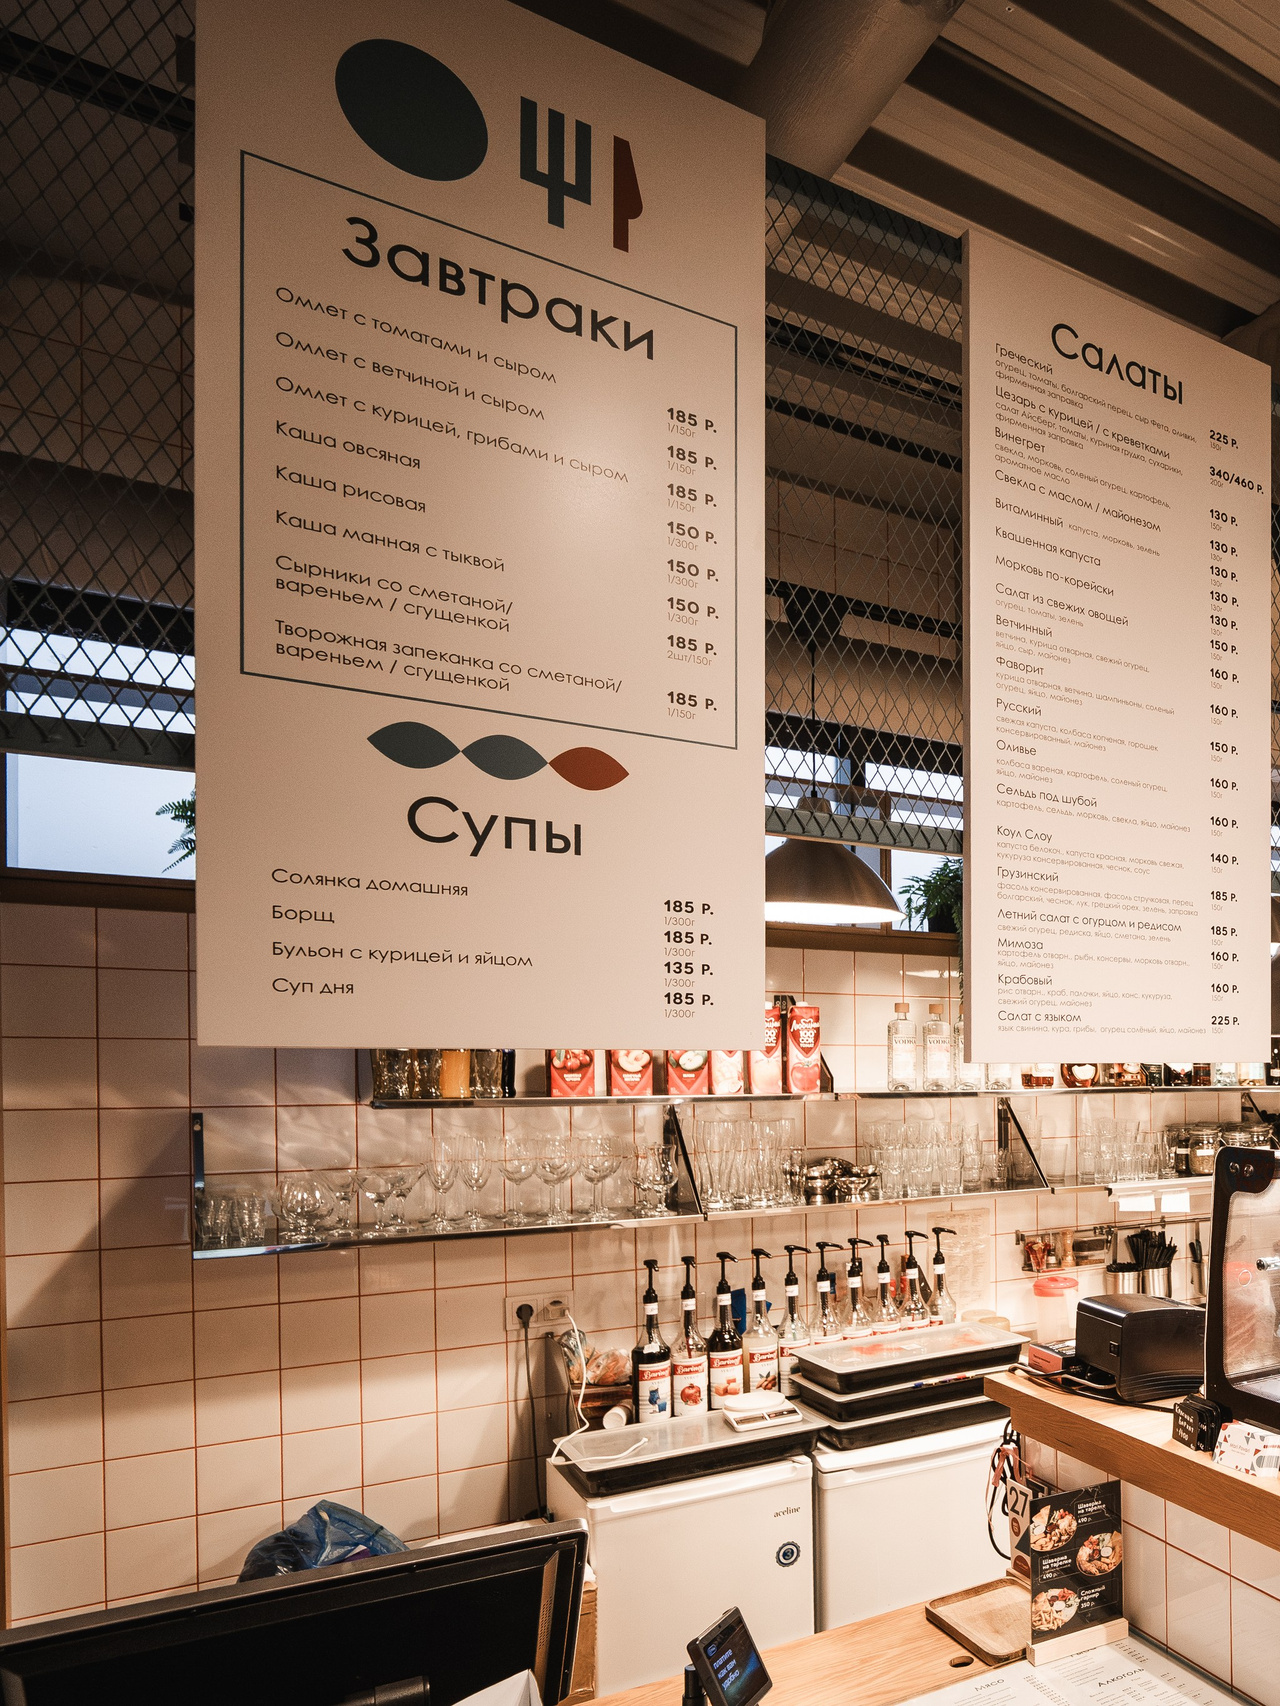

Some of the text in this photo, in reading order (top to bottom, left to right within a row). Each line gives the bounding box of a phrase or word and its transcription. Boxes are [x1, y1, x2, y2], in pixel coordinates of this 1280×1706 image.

[342, 217, 653, 360] Завтраки
[276, 288, 556, 383] Омлет с томатами и сыром
[996, 343, 1052, 374] Греческий
[1051, 323, 1183, 404] Салаты
[667, 409, 698, 428] 185
[276, 377, 628, 482] Омлет с курицей, грибами и сыром
[668, 423, 695, 437] 1/150г
[995, 427, 1045, 452] Винегрет
[276, 420, 420, 469] Каша овсяная
[1210, 466, 1254, 490] 340/460
[277, 465, 425, 513] Каша рисовая
[996, 498, 1063, 527] Витаминный
[276, 510, 504, 571] Каша манная с тыквой
[996, 526, 1100, 566] Квашенная капуста
[667, 560, 699, 578] 150
[996, 555, 1113, 596] Морковь по-корейски
[276, 556, 513, 615] Сырники со сметаной/
[276, 579, 509, 632] вареньем / сгущенкой
[996, 615, 1052, 637] Ветчинный
[667, 650, 716, 665] 2шт/150г
[996, 657, 1044, 675] Фаворит
[997, 698, 1041, 716] Русский
[997, 740, 1036, 755] Оливье
[997, 783, 1097, 807] Сельдь под шубой
[407, 796, 581, 857] Супы
[997, 826, 1052, 845] Коул Слоу
[272, 869, 467, 896] Солянка домашняя
[998, 867, 1058, 882] Грузинский
[1211, 891, 1227, 901] 185
[273, 905, 334, 923] Борщ
[664, 900, 694, 913] 185
[273, 942, 532, 966] Бульон с курицей и яйцом
[997, 938, 1043, 950] Мимоза
[664, 962, 693, 974] 135
[272, 978, 353, 995] Суп дня
[998, 974, 1052, 986] Крабовый
[998, 1011, 1032, 1021] Салат
[1045, 1014, 1081, 1022] языком
[1212, 1016, 1229, 1025] 225
[773, 1506, 801, 1518] aceline
[1010, 1486, 1029, 1518] 27
[784, 1548, 792, 1560] 3
[1043, 1555, 1068, 1566] Шаверма
[974, 1678, 1005, 1692] Мясо
[1097, 1667, 1145, 1688] Алкоголь
